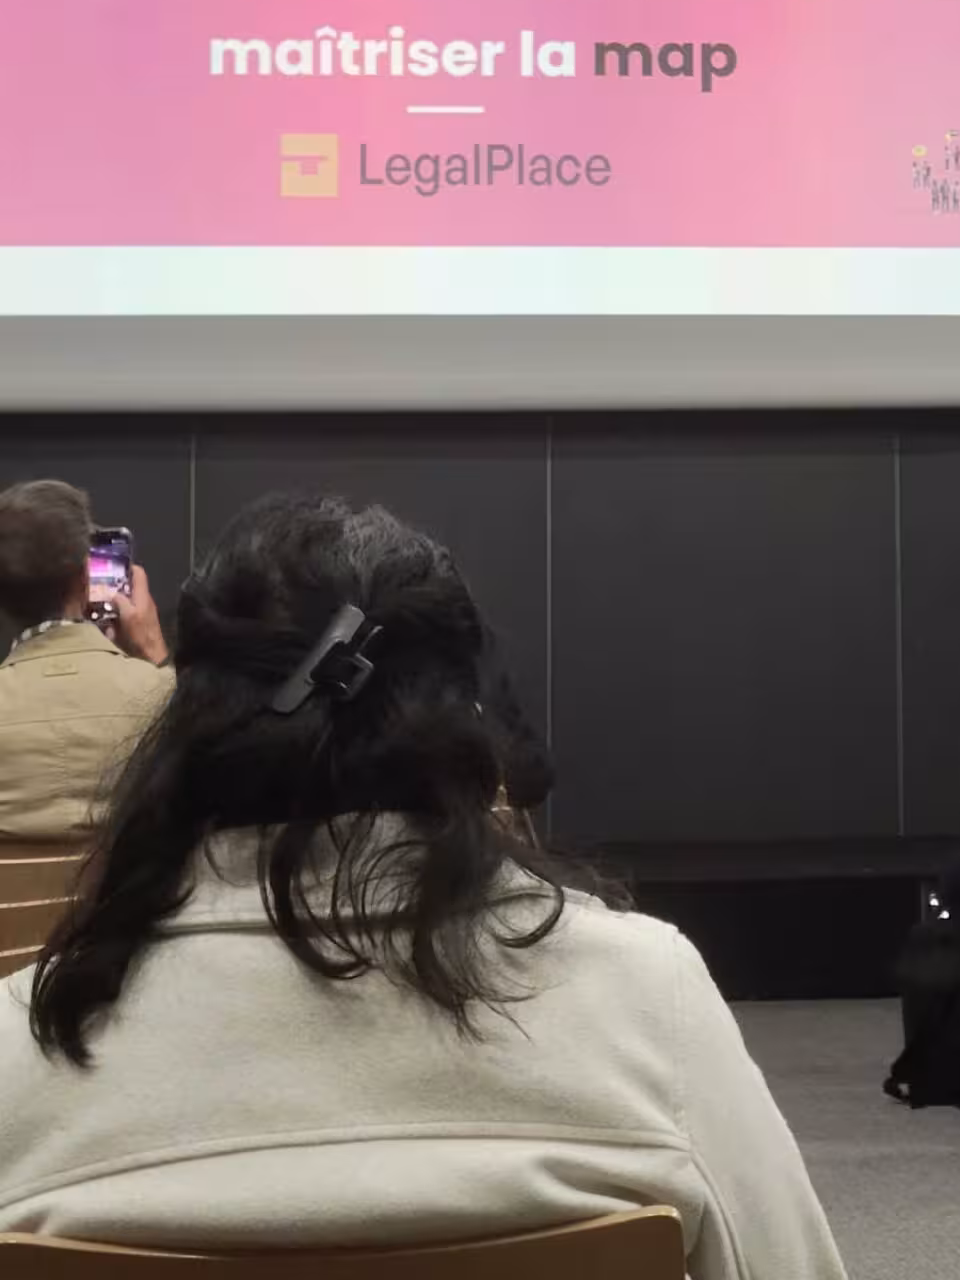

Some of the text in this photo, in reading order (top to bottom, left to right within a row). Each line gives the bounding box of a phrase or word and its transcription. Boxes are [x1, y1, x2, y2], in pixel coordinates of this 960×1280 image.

[210, 26, 738, 93] maîtriser la map
[359, 144, 612, 196] LegalPlace
